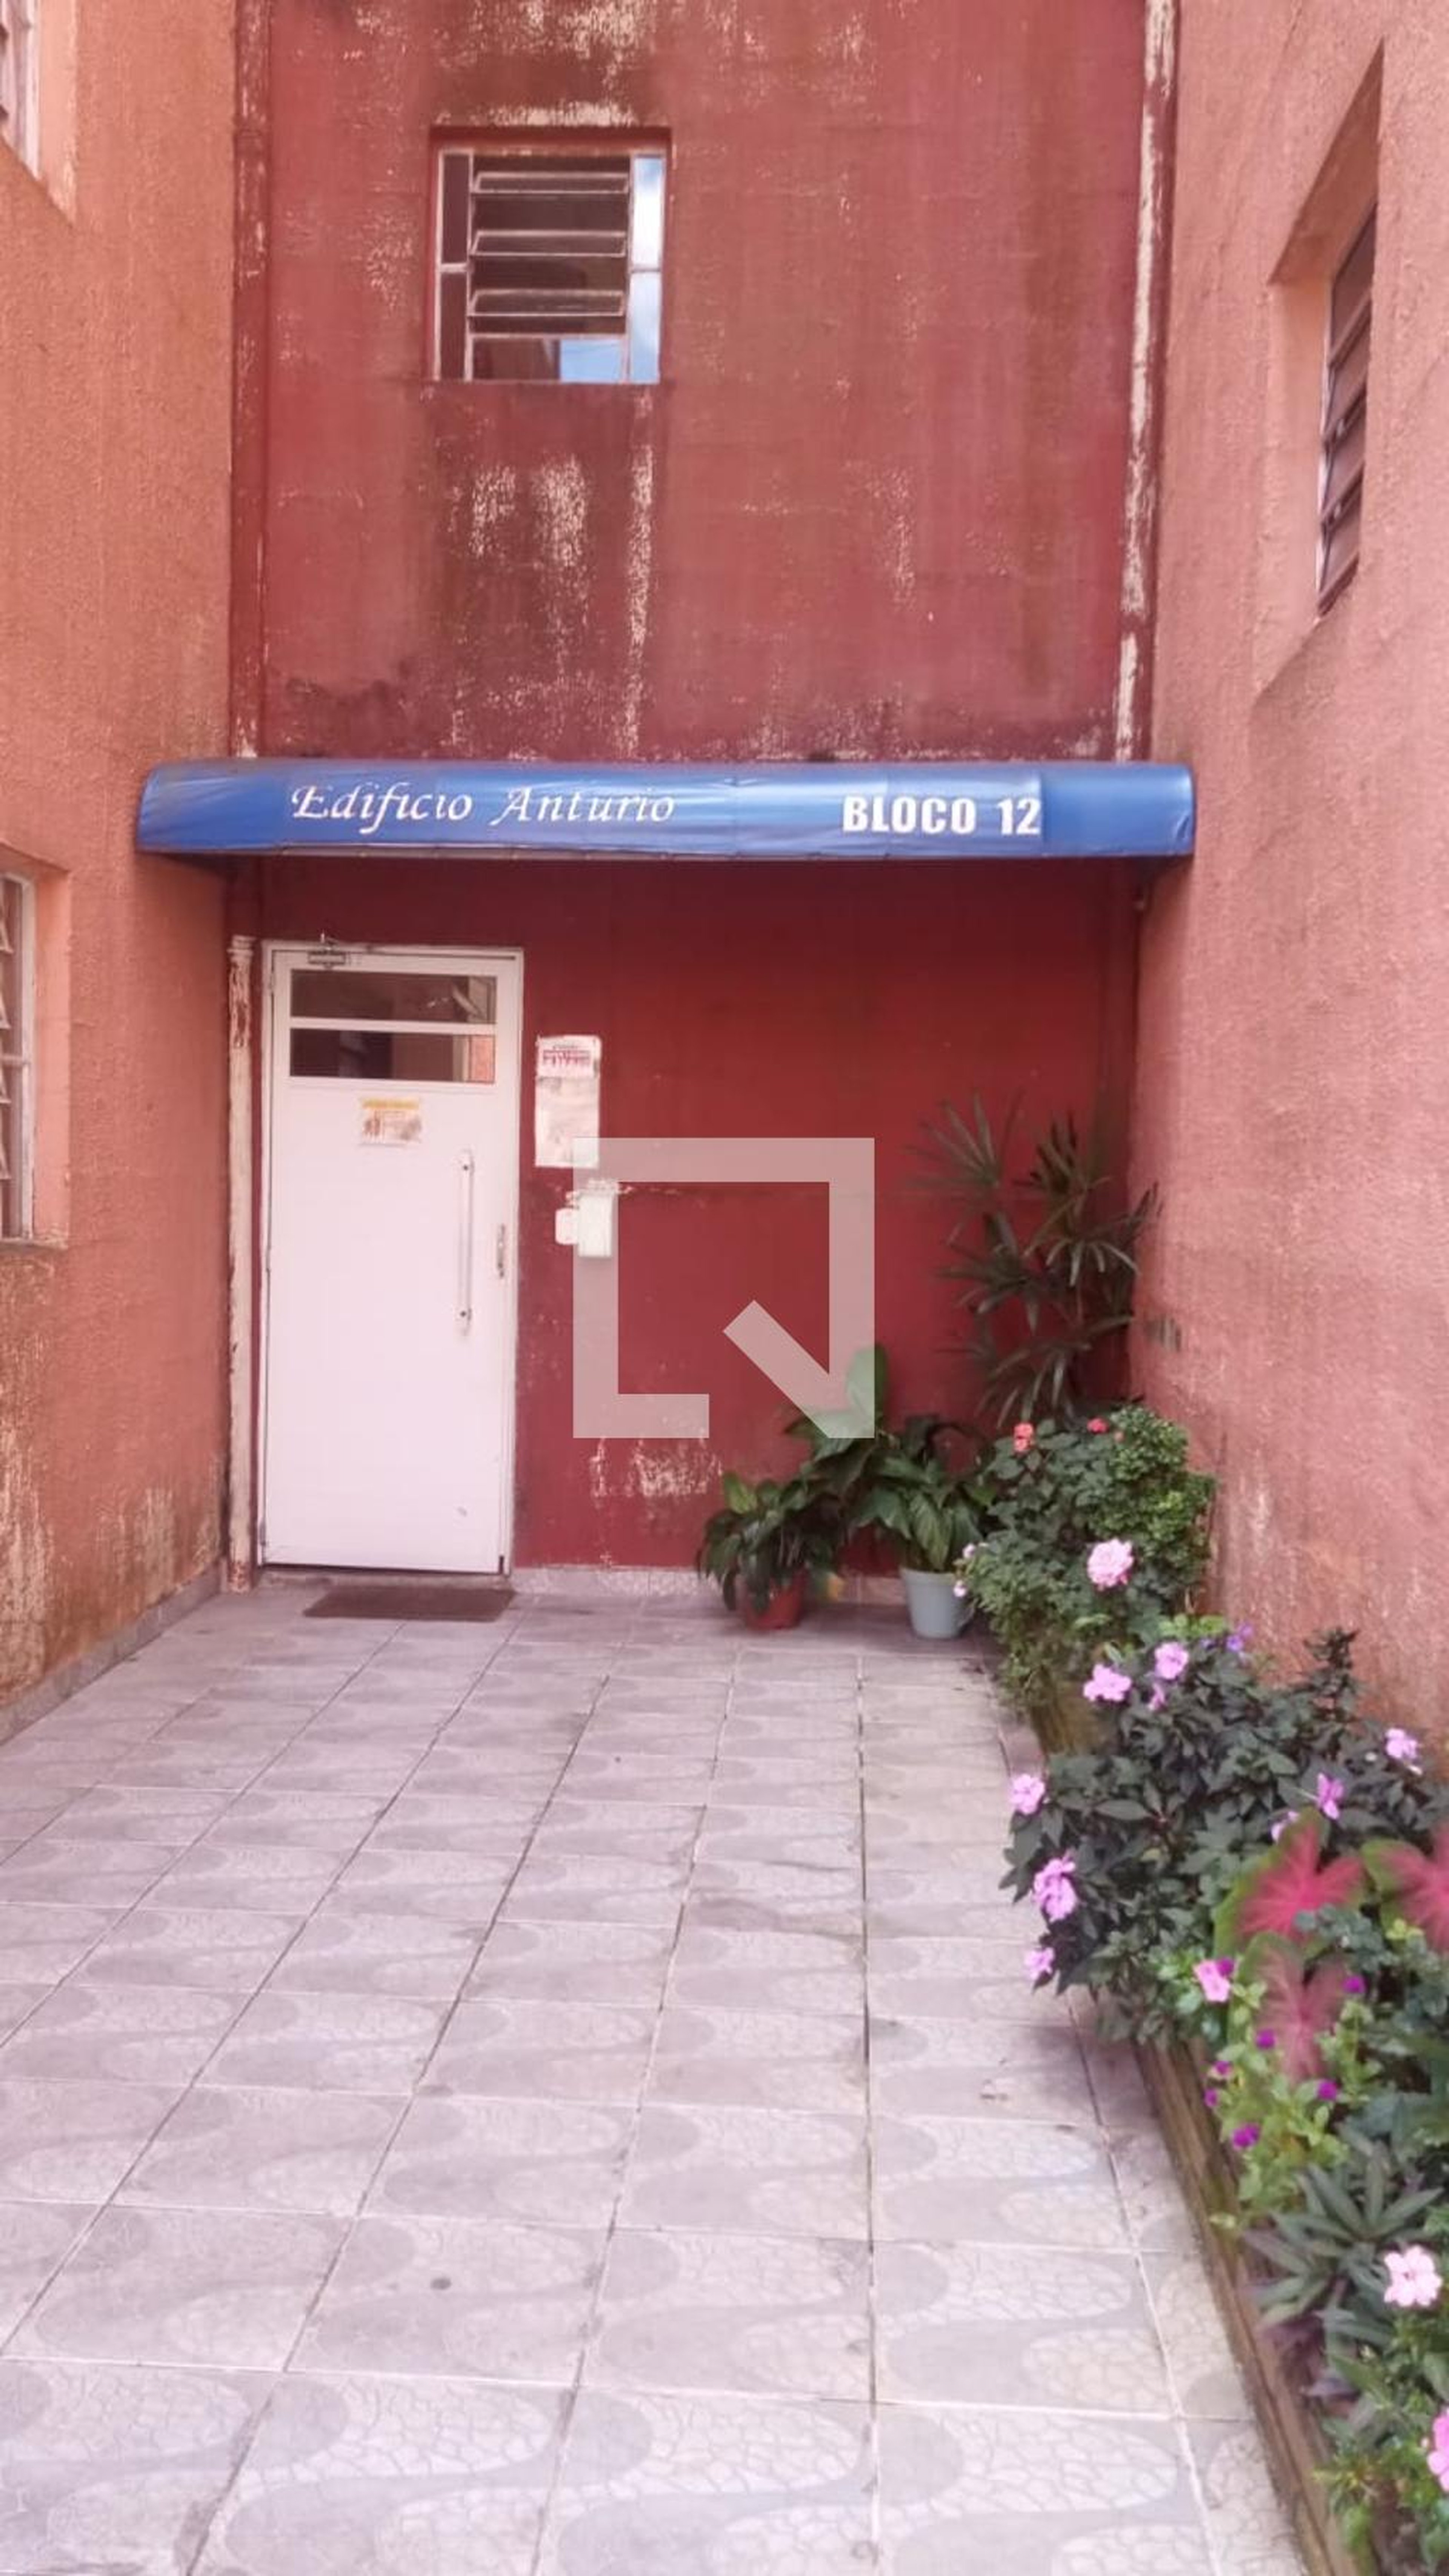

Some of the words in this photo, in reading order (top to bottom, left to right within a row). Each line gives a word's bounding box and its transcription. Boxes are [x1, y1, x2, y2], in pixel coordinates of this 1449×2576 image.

[489, 786, 675, 826] Anturio
[842, 796, 976, 835] BLOCO
[997, 797, 1041, 835] 12
